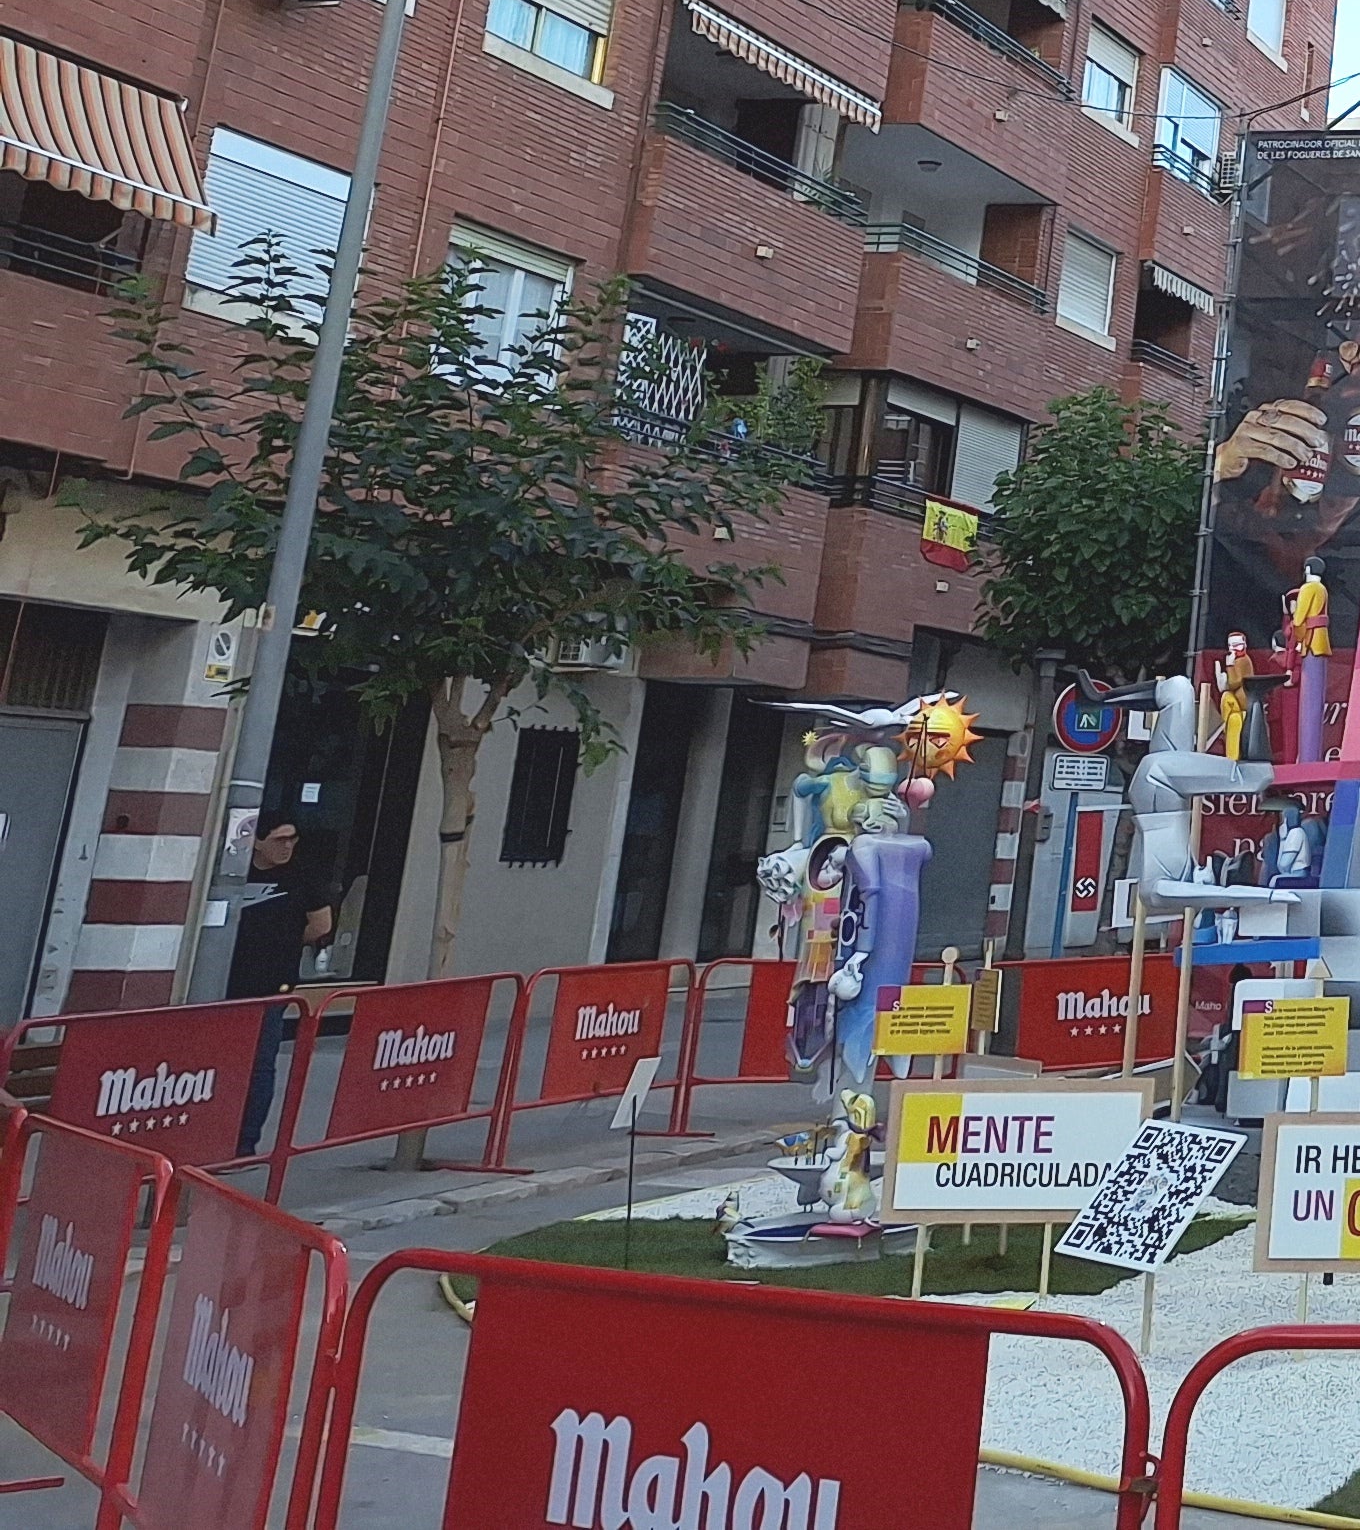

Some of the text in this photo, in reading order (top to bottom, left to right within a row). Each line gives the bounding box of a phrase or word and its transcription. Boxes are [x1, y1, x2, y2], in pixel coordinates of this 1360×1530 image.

[1257, 139, 1323, 149] PATROCINADOR
[1325, 138, 1356, 148] OFICIAL
[1257, 151, 1270, 160] DE
[1271, 150, 1286, 160] LES
[1287, 150, 1331, 159] FOGUERES
[1333, 150, 1343, 159] DE
[575, 1002, 641, 1041] Mahou
[373, 1025, 456, 1070] Mahou
[96, 1061, 216, 1116] Mahou
[926, 1115, 1055, 1154] MENTE
[1295, 1145, 1322, 1174] IR
[1292, 1189, 1335, 1221] UN
[546, 1408, 841, 1530] Mahou
